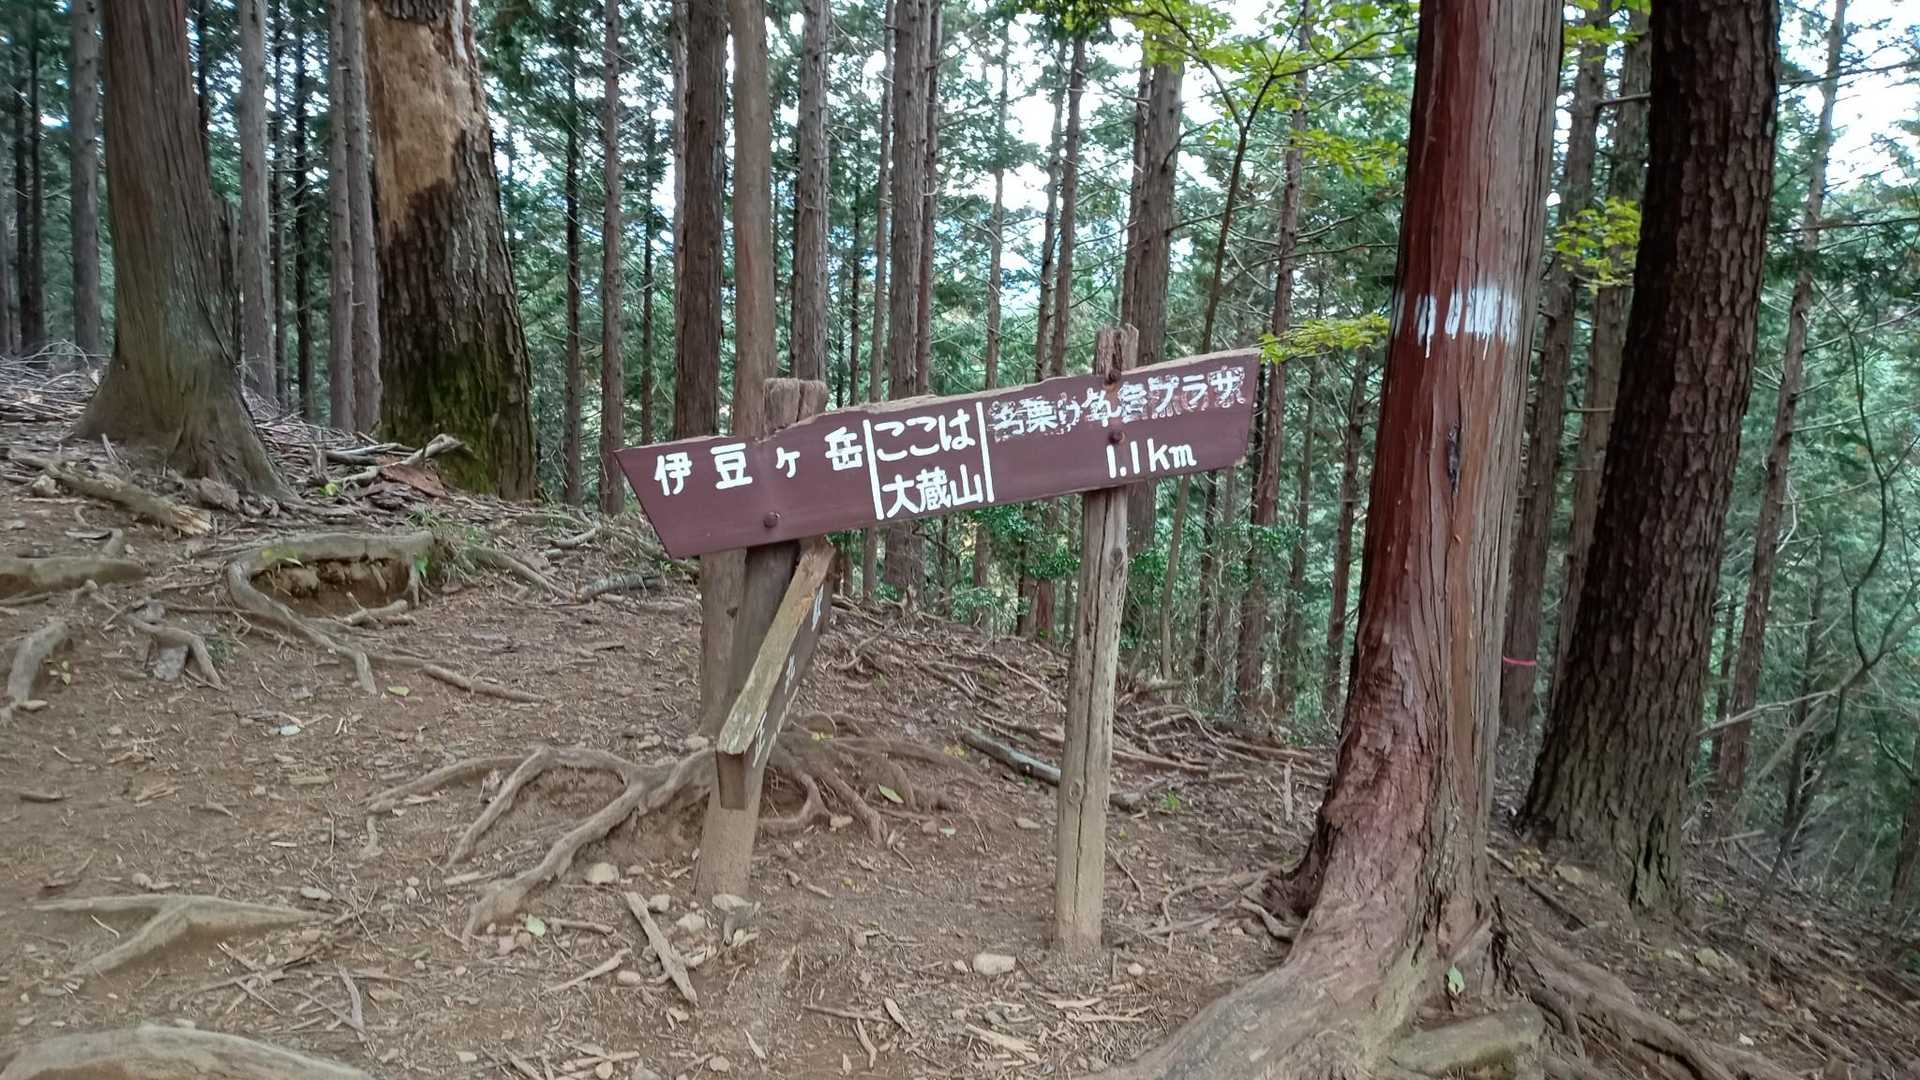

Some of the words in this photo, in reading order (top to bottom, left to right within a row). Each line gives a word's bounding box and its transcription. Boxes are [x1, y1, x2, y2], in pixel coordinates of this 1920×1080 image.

[874, 409, 976, 462] ここは
[882, 465, 983, 516] 大蔵山
